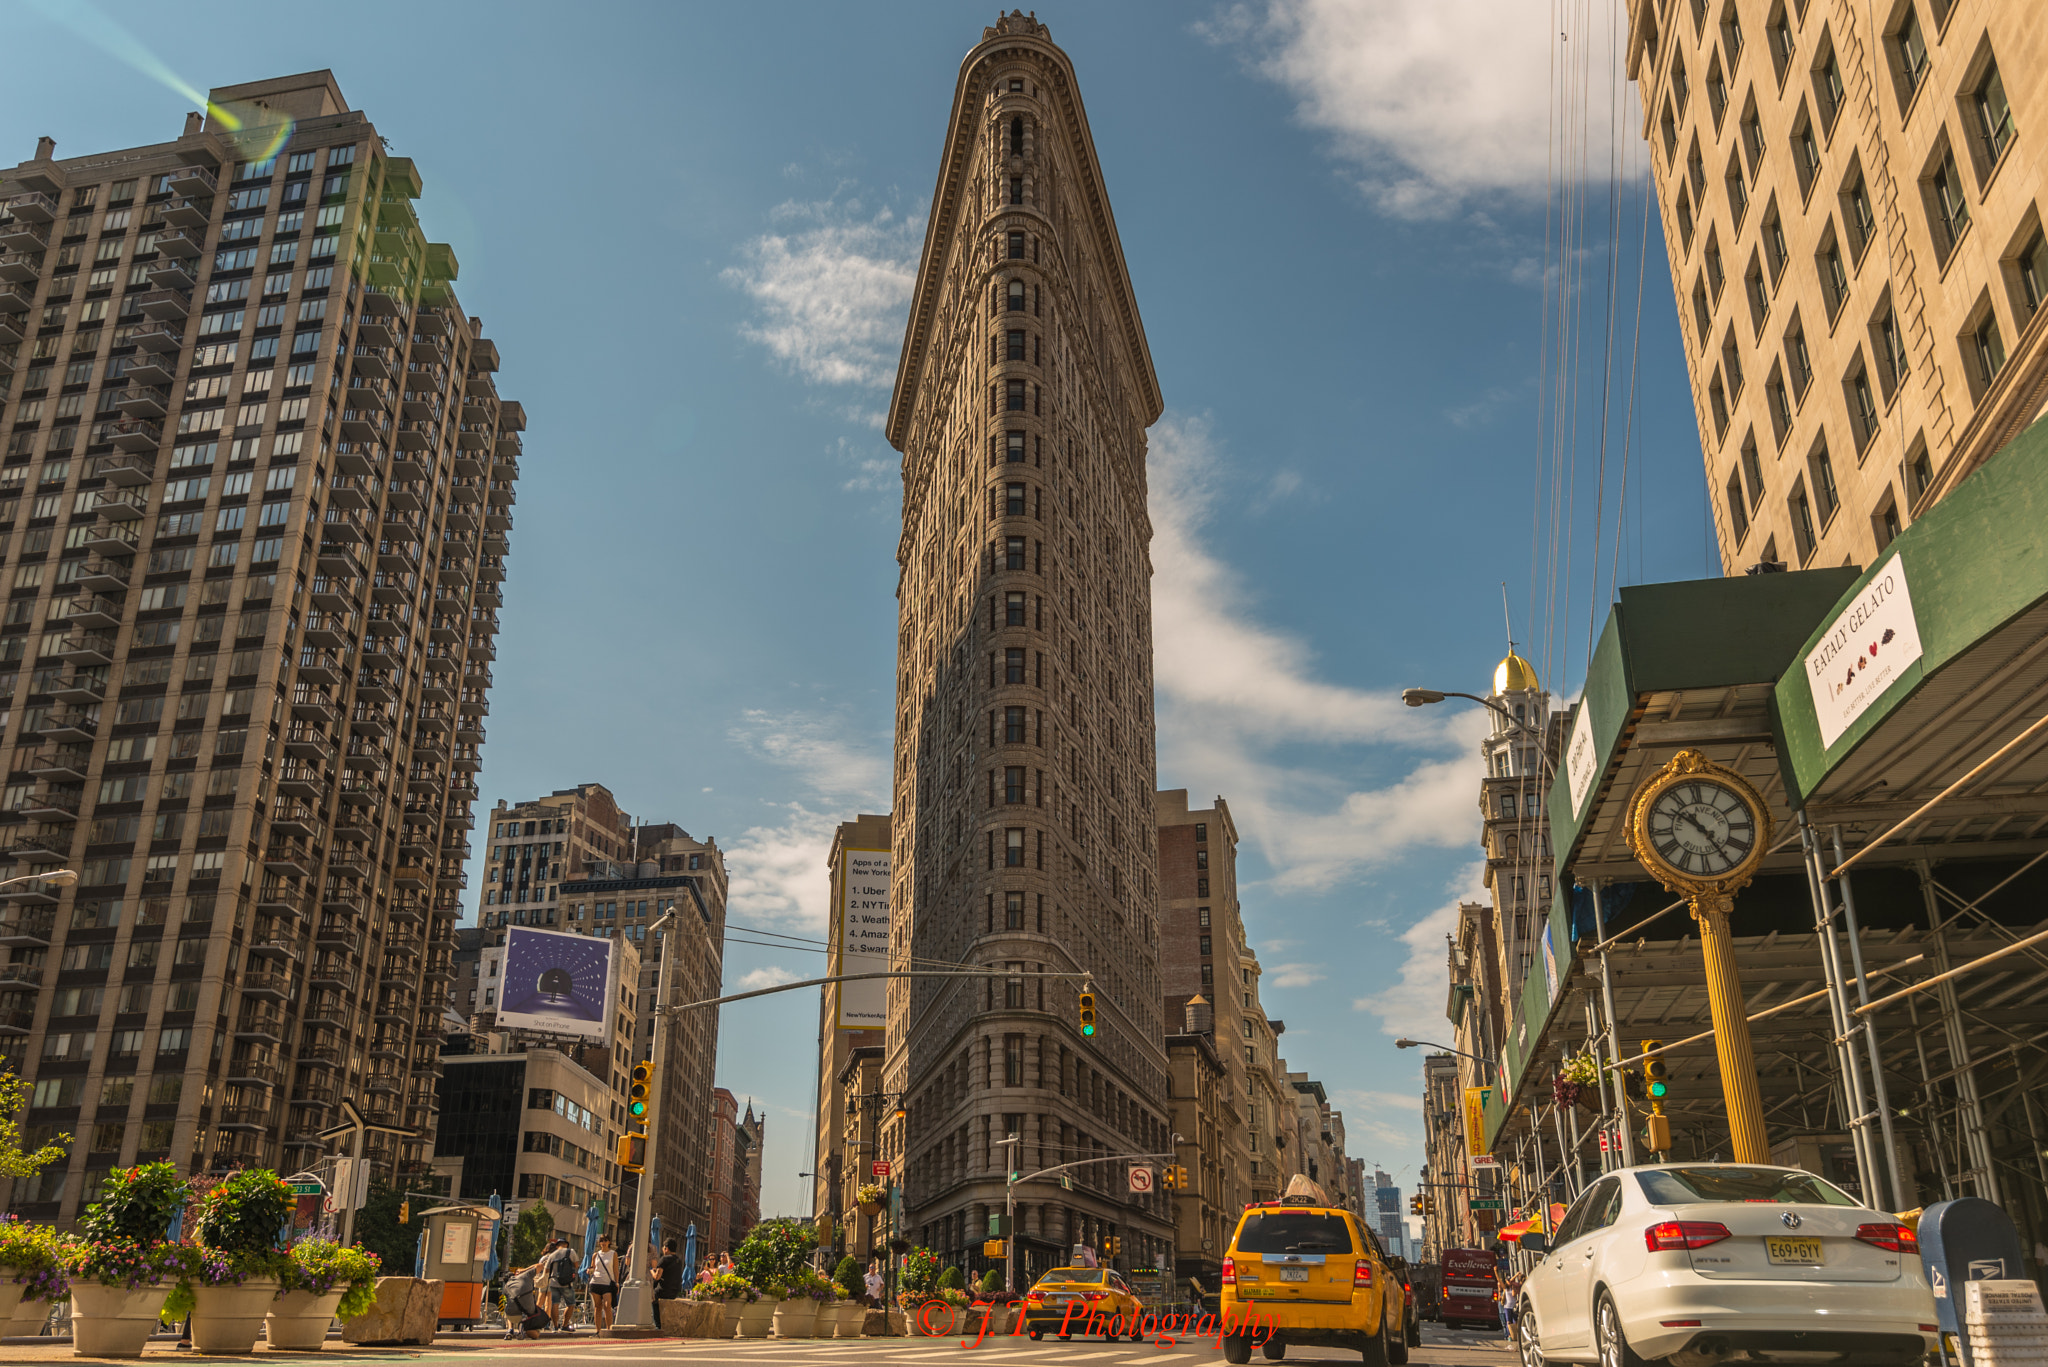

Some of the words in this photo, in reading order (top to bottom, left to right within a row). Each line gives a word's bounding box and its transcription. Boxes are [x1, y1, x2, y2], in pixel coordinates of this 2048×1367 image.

[1813, 625, 1849, 677] EATALY
[1849, 575, 1894, 633] GELATO
[1695, 806, 1726, 827] AVENUE
[1683, 837, 1725, 853] BUILDIG
[852, 859, 872, 867] Apps
[852, 886, 860, 894] 1.
[863, 886, 886, 895] Uber
[850, 900, 859, 909] 2.
[850, 914, 858, 923] 3.
[849, 929, 858, 938] 4.
[849, 944, 857, 953] 5.
[552, 1021, 570, 1029] iPhone
[1473, 1143, 1481, 1153] 10
[304, 1185, 311, 1193] St
[1770, 1243, 1792, 1258] E69
[1798, 1243, 1820, 1258] GYY
[1448, 1259, 1492, 1269] Excellence
